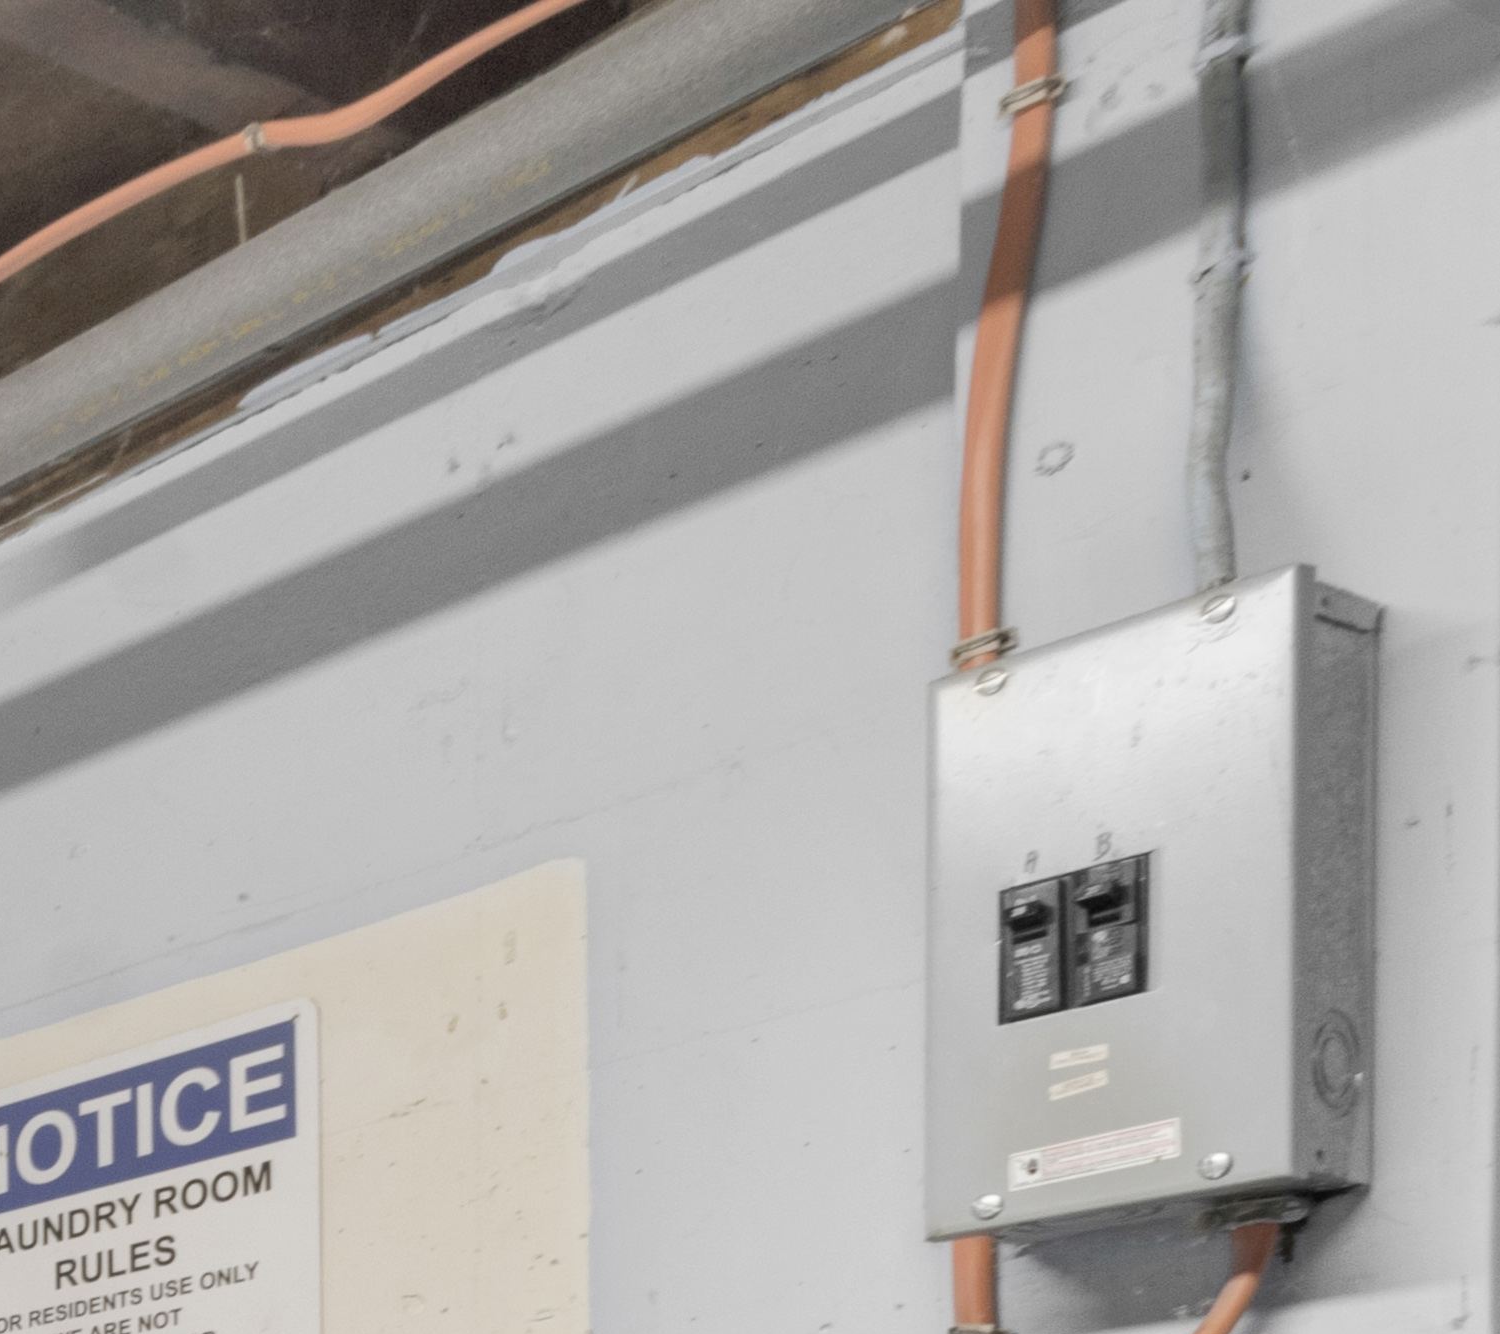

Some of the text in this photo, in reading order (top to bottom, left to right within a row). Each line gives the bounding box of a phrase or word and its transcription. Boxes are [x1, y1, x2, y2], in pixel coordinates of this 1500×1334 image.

[153, 1160, 273, 1219] ROOM
[55, 1235, 177, 1290] RULES
[28, 1287, 143, 1328] RESIDENTS
[150, 1276, 193, 1301] USE
[200, 1261, 259, 1290] ONLY
[138, 1308, 182, 1334] NOT
